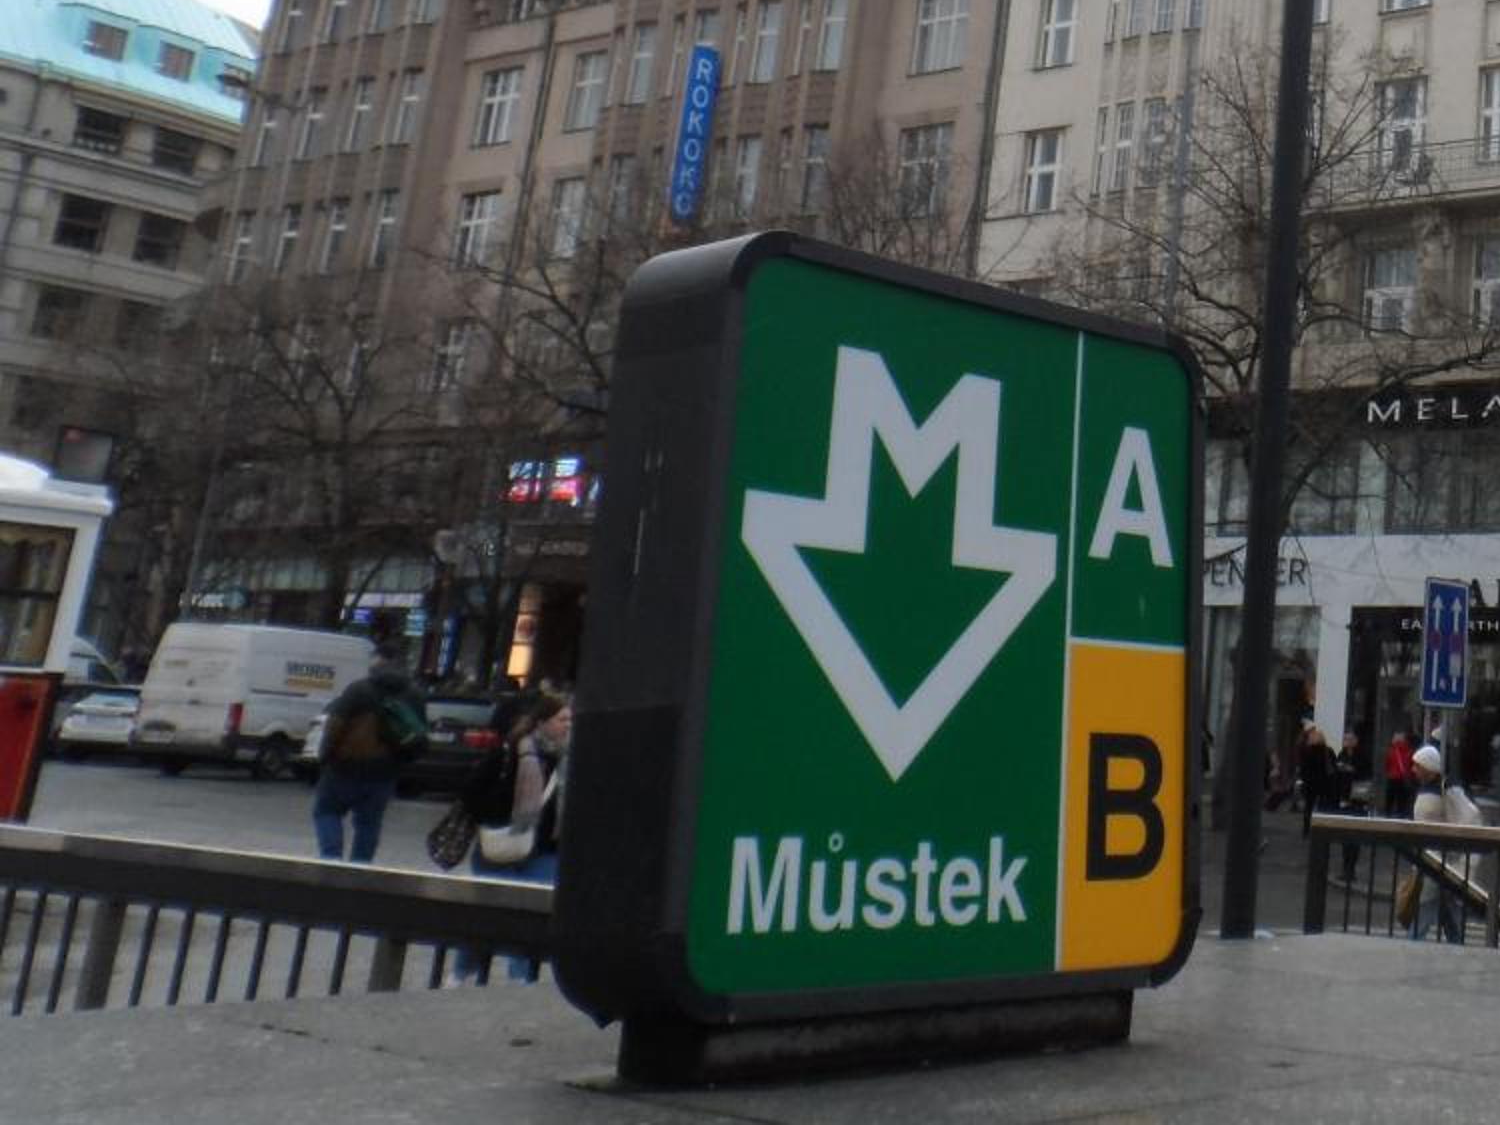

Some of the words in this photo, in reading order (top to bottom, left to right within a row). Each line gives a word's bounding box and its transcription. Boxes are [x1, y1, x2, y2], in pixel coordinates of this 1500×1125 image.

[675, 58, 713, 215] ROKOKO
[1088, 426, 1174, 567] A
[1085, 732, 1165, 882] B
[727, 832, 1029, 934] Můstek
